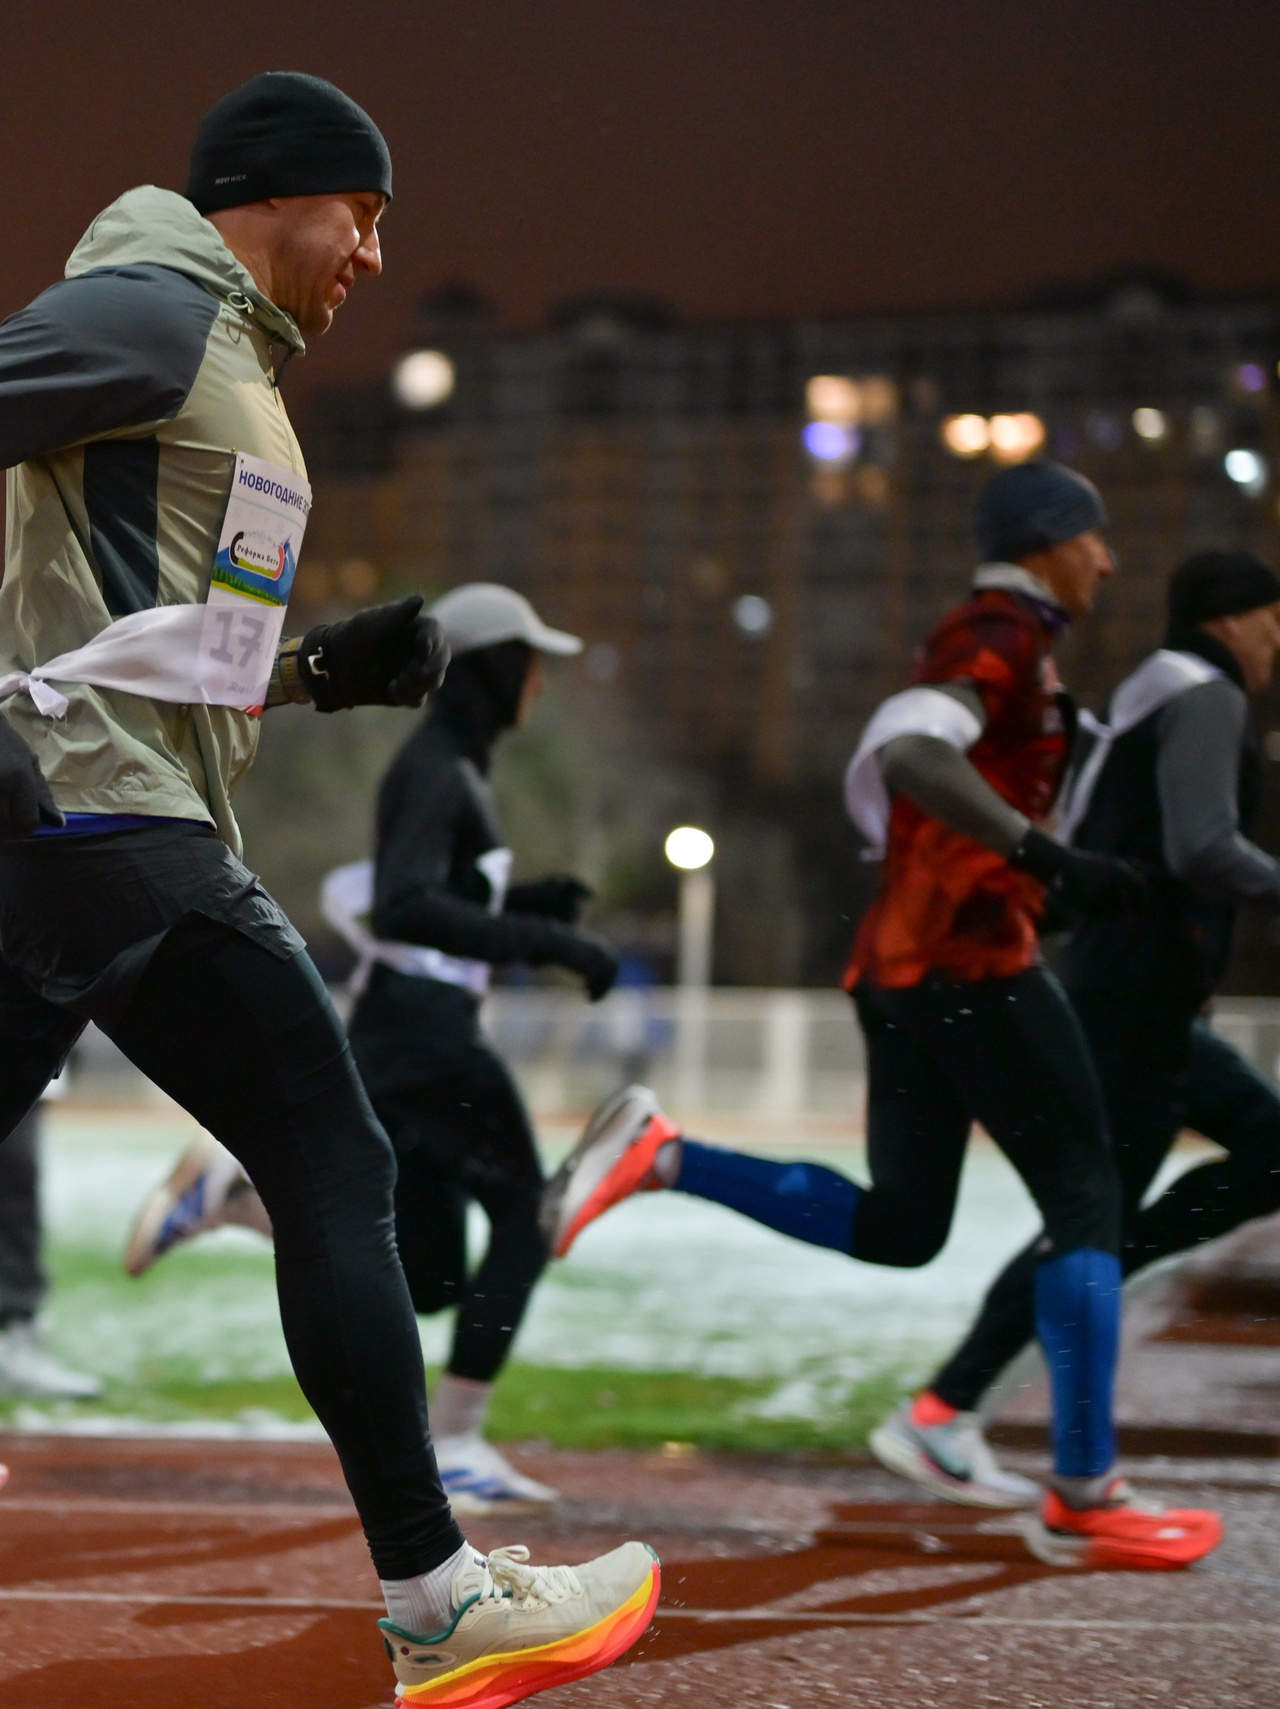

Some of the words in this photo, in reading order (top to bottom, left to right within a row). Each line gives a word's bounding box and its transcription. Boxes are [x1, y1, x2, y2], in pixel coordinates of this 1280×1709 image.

[239, 469, 303, 511] НОВОГОДНИЕ
[237, 544, 265, 561] Реформа
[209, 611, 264, 667] 17
